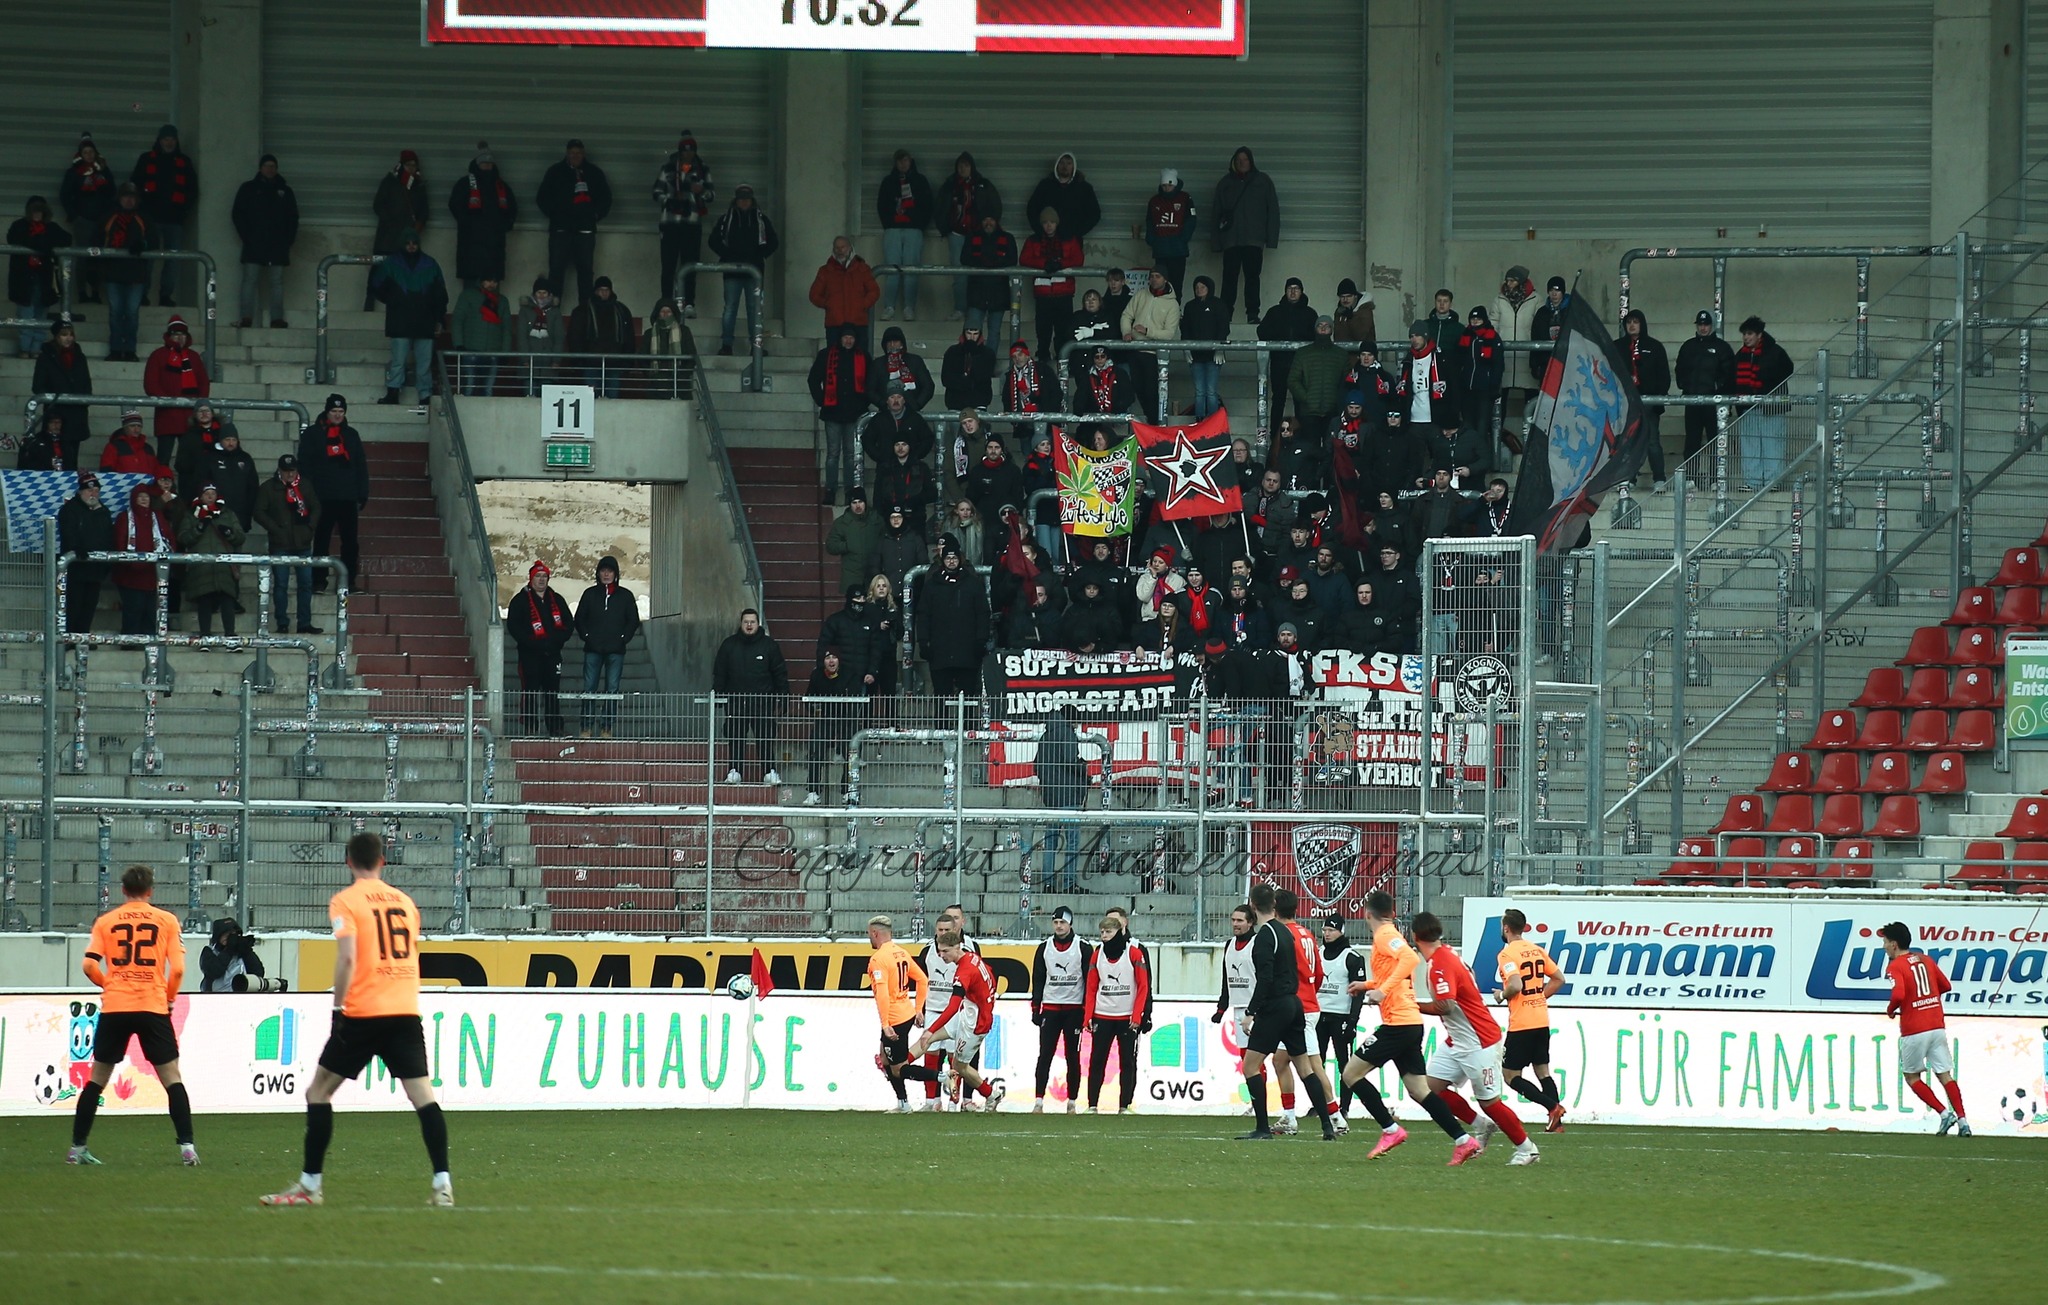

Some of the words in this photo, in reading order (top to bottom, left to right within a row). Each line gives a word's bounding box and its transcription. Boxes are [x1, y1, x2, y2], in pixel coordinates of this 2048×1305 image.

[553, 399, 580, 428] 11
[1031, 650, 1068, 661] VEREIN
[1311, 649, 1399, 684] FKS
[1007, 686, 1176, 715] INGOLSTADT
[1302, 843, 1356, 880] SCHANZER
[1252, 863, 1284, 891] Scha
[118, 912, 153, 920] LORENZ
[1577, 921, 1774, 938] Wohn-Centrum
[111, 923, 159, 967] 32
[372, 907, 410, 960] 16
[1471, 916, 1776, 995] Lhrmann
[1520, 959, 1545, 996] 29
[1584, 985, 1609, 997] an
[1618, 983, 1671, 998] der
[1678, 984, 1767, 999] Saline
[1911, 963, 1931, 998] 10
[1970, 990, 2018, 1003] der
[540, 1011, 838, 1092] ZUHAUSE.
[1615, 1013, 1694, 1107] FÜR
[252, 1073, 295, 1095] GWG
[1150, 1080, 1204, 1101] GWG
